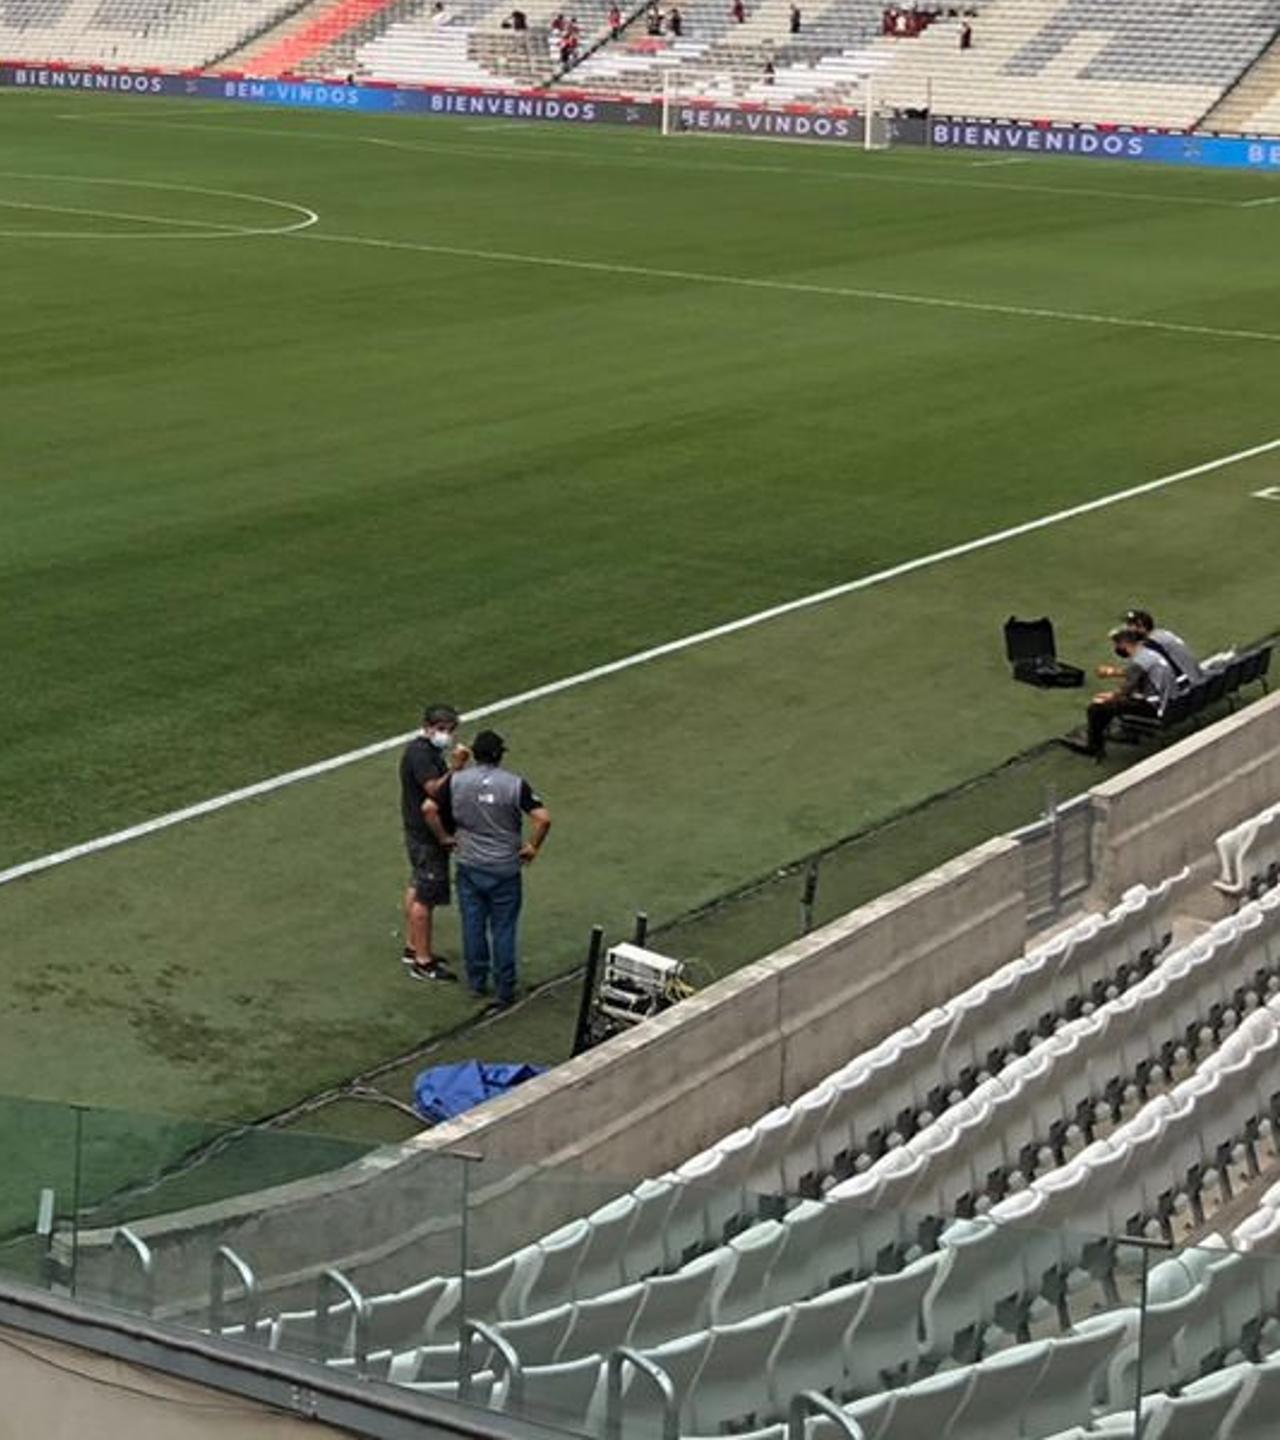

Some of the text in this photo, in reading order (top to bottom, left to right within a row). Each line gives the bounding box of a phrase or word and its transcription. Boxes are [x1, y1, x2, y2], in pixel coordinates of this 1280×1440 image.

[15, 69, 163, 93] BIENVENIDOS
[224, 80, 359, 106] BEM-VINDOS
[431, 94, 596, 121] BIENVENIDOS
[681, 109, 849, 136] BEM-VINDOS
[934, 123, 1144, 155] BIENVENIDOS
